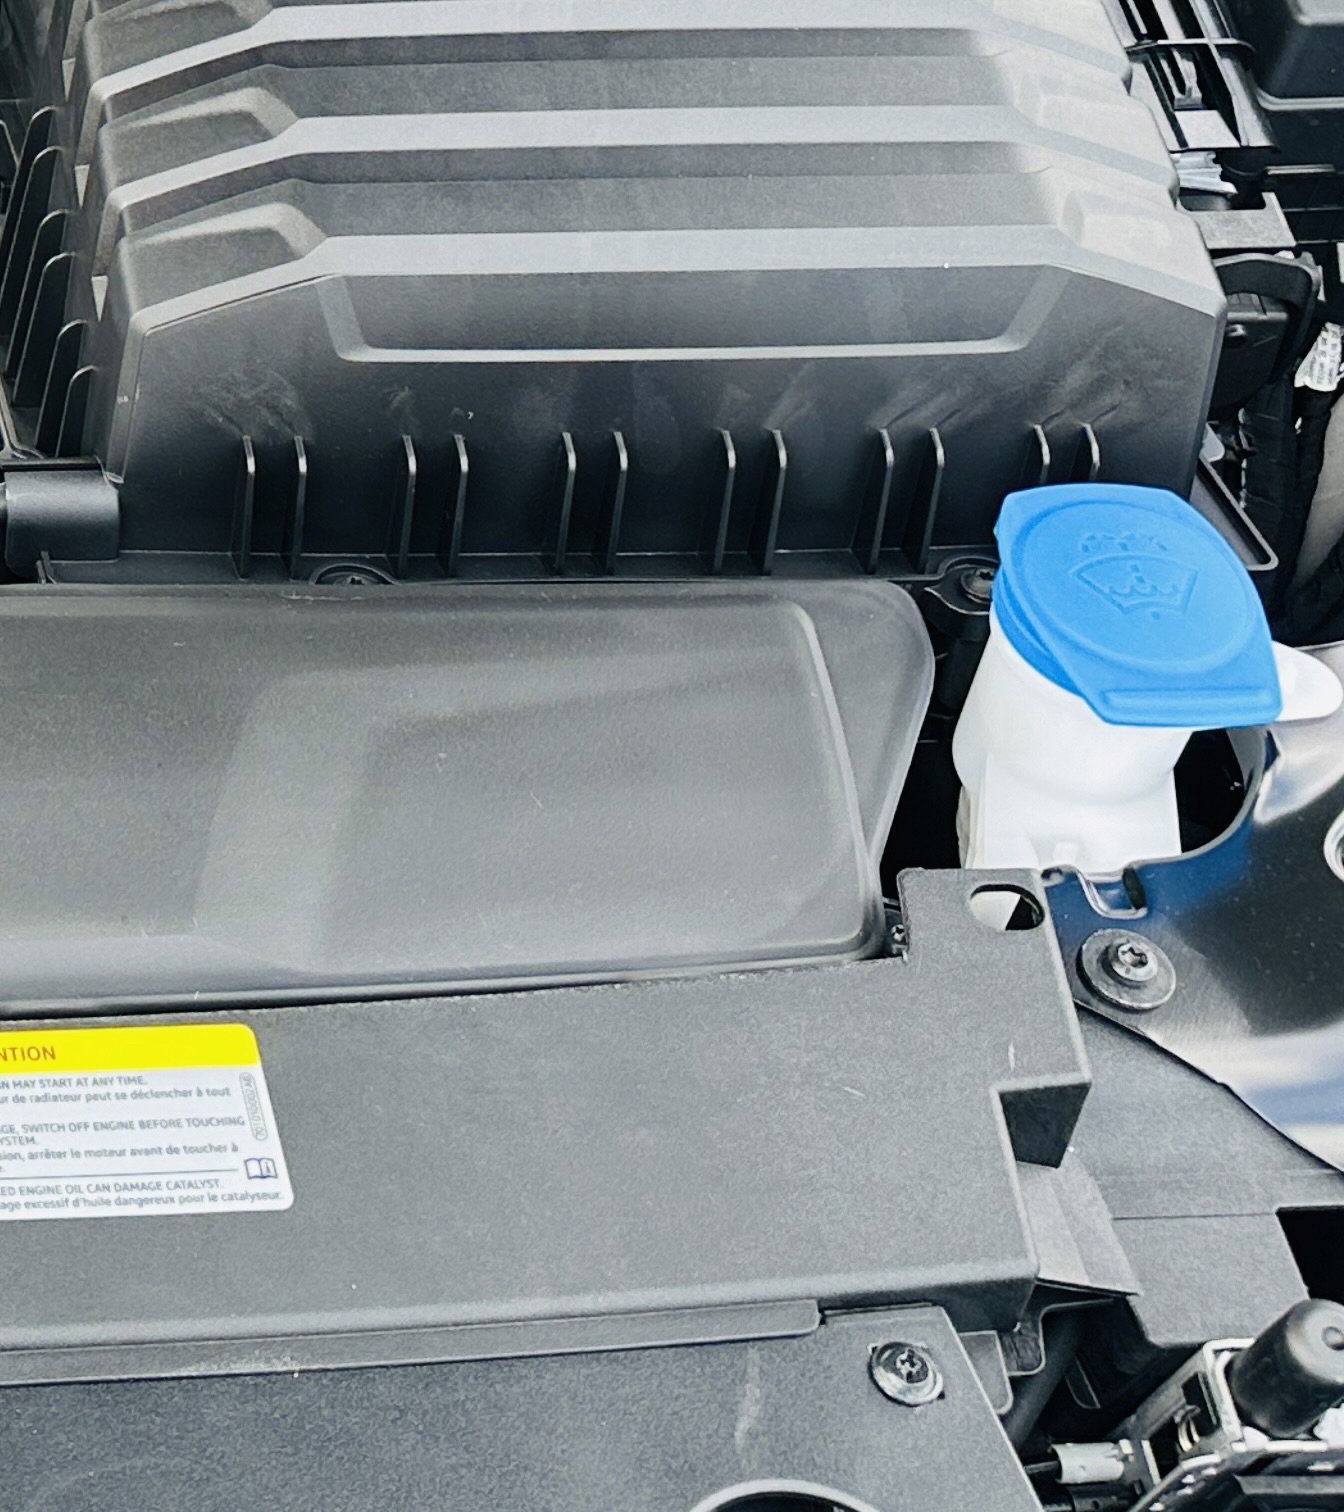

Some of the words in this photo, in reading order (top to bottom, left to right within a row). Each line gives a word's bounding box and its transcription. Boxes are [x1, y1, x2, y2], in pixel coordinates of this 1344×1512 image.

[12, 1080, 36, 1089] MAY
[39, 1078, 72, 1088] START
[76, 1078, 89, 1087] AT
[92, 1076, 114, 1086] ANY
[12, 1094, 26, 1104] de
[30, 1093, 81, 1103] radiateur
[85, 1092, 112, 1104] peut
[115, 1092, 127, 1100] se
[130, 1089, 192, 1099] déclencher
[196, 1087, 203, 1097] à
[206, 1087, 230, 1096] tout
[22, 1123, 65, 1133] SWITCH
[69, 1122, 90, 1132] OFF
[92, 1120, 135, 1131] ENGINE
[139, 1119, 183, 1130] BEFORE
[185, 1116, 245, 1127] TOUCHING
[70, 1149, 81, 1159] le
[84, 1147, 126, 1158] moteur
[130, 1146, 162, 1156] avant
[166, 1145, 180, 1155] de
[183, 1143, 227, 1154] toucher
[231, 1142, 238, 1152] à
[20, 1185, 62, 1196] ENGINE
[66, 1185, 83, 1195] OIL
[87, 1183, 111, 1193] CAN
[114, 1181, 161, 1193] DAMAGE
[24, 1198, 69, 1209] excessif
[115, 1195, 175, 1207] dangereux
[178, 1194, 204, 1205] pour
[207, 1192, 218, 1202] le
